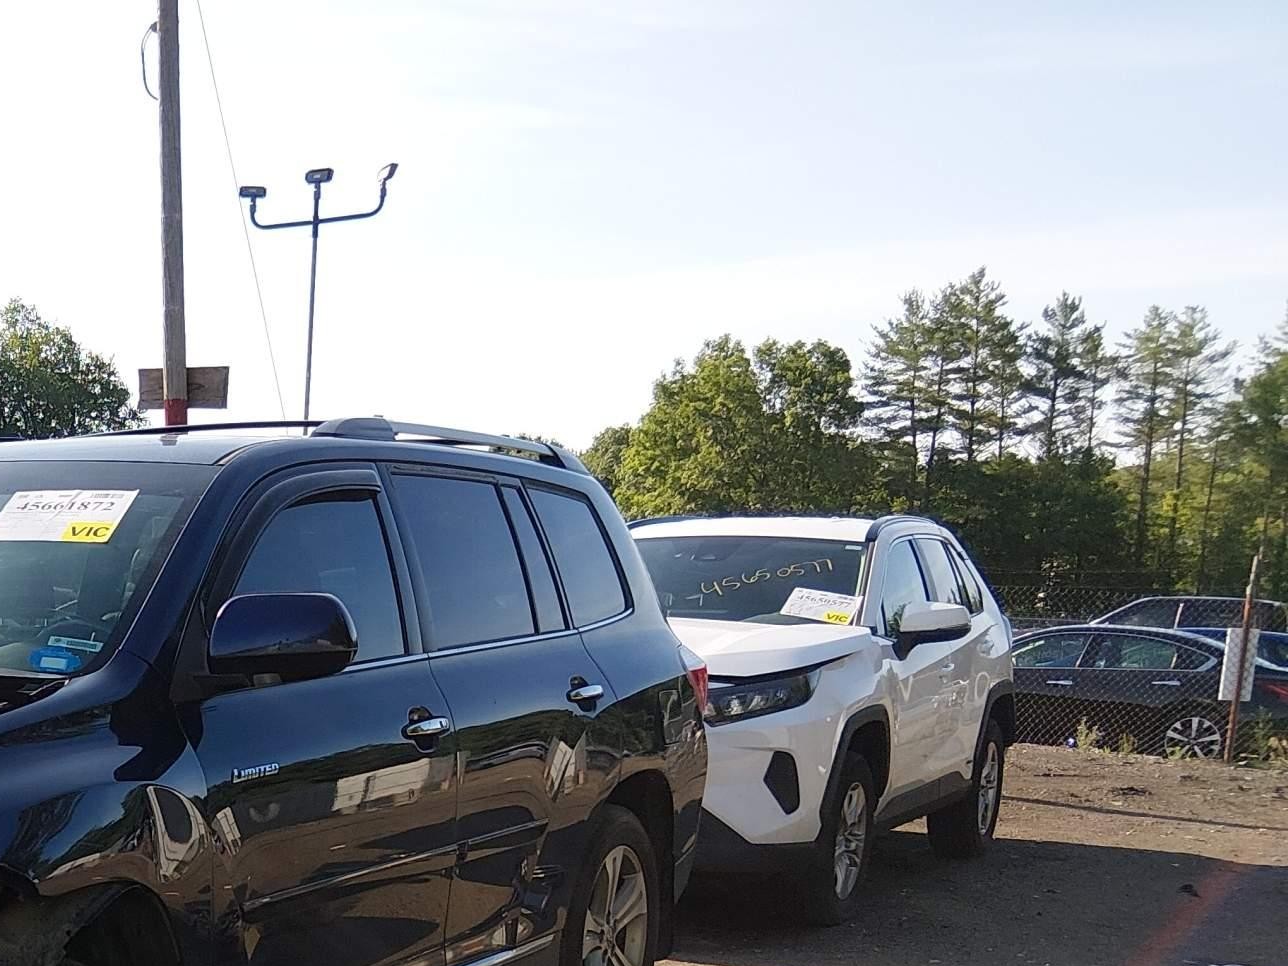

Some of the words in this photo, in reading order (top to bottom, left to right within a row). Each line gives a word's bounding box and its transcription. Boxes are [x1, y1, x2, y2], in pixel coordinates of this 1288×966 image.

[16, 501, 115, 511] 45661872
[72, 526, 110, 538] VIC
[700, 558, 833, 596] 45650577
[827, 613, 849, 623] VIC
